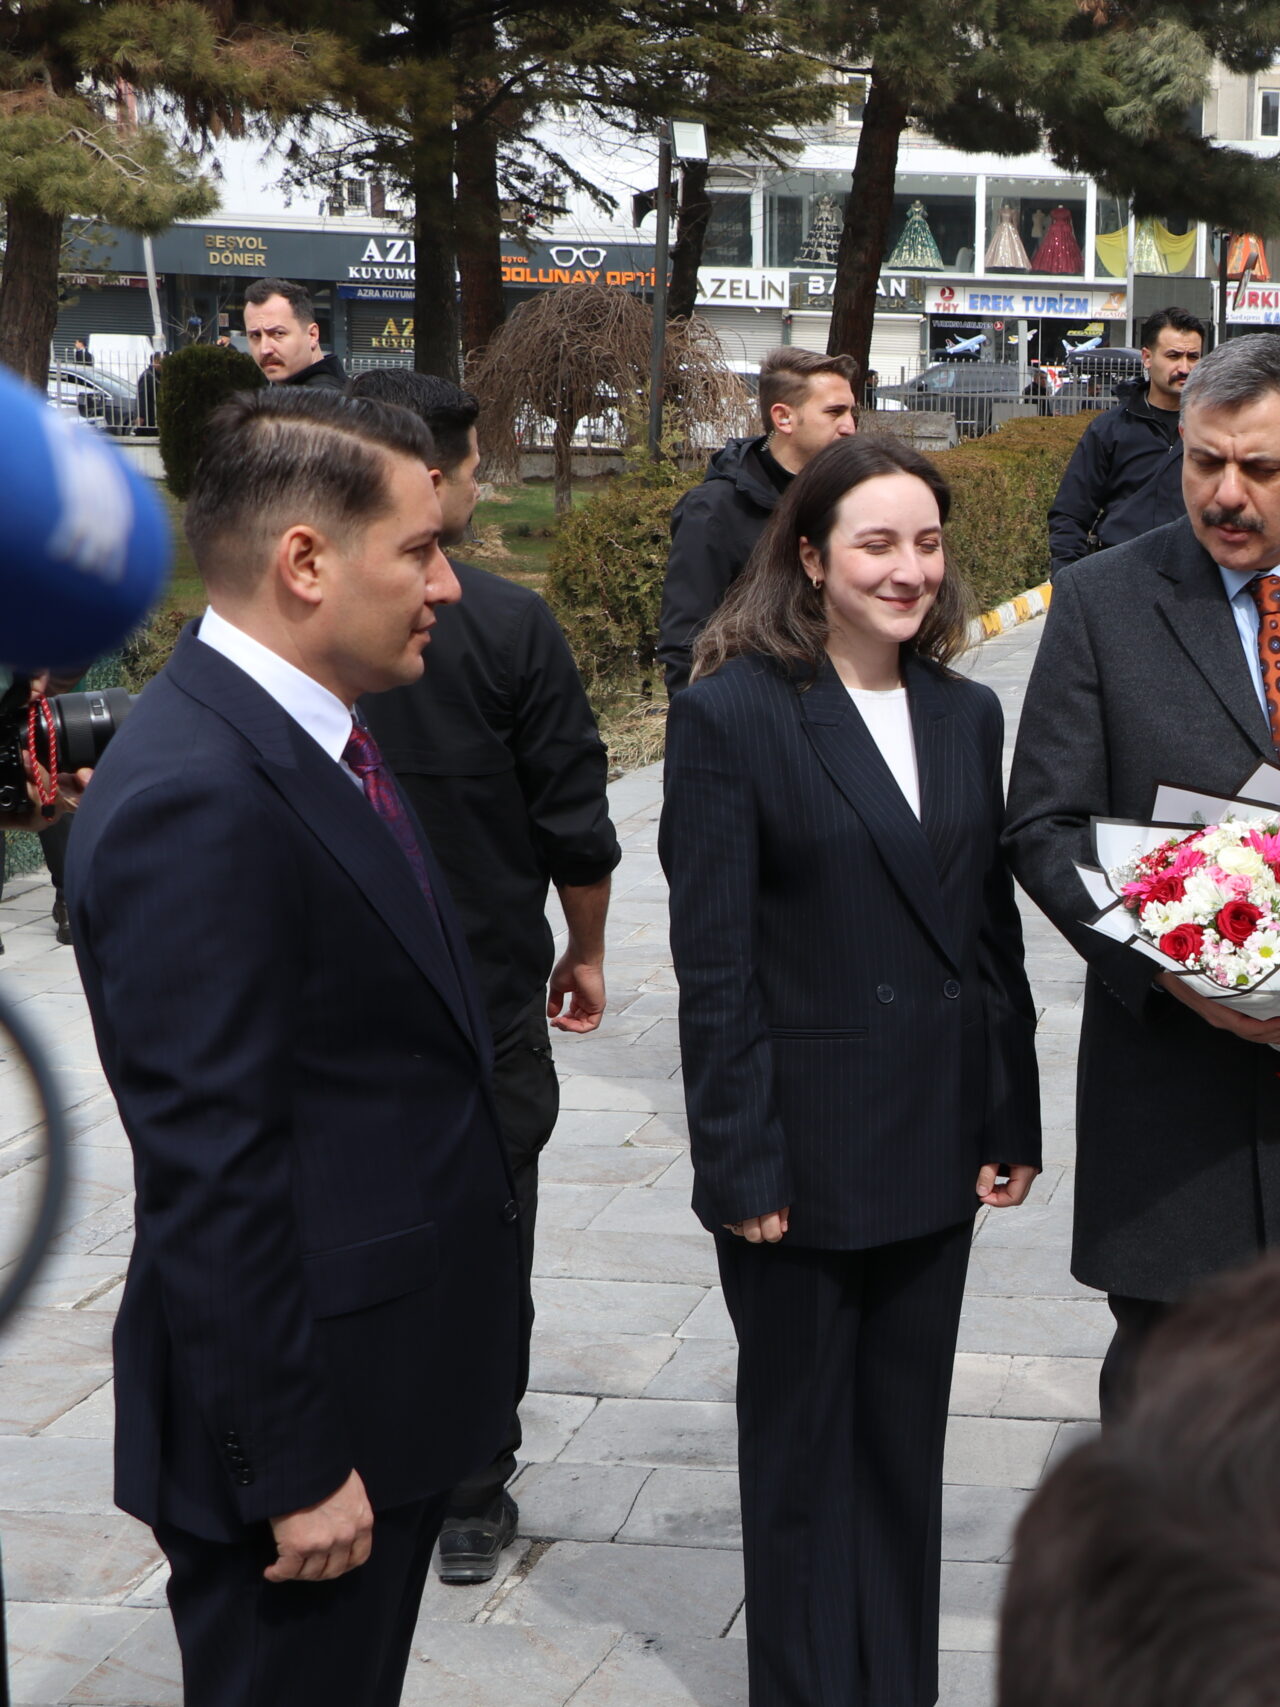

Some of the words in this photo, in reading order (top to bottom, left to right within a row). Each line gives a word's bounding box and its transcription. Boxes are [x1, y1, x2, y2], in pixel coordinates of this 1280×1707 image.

[209, 250, 266, 267] DÖNER
[935, 303, 959, 313] THY
[968, 294, 1015, 311] EREK
[1022, 293, 1089, 314] TURİZM
